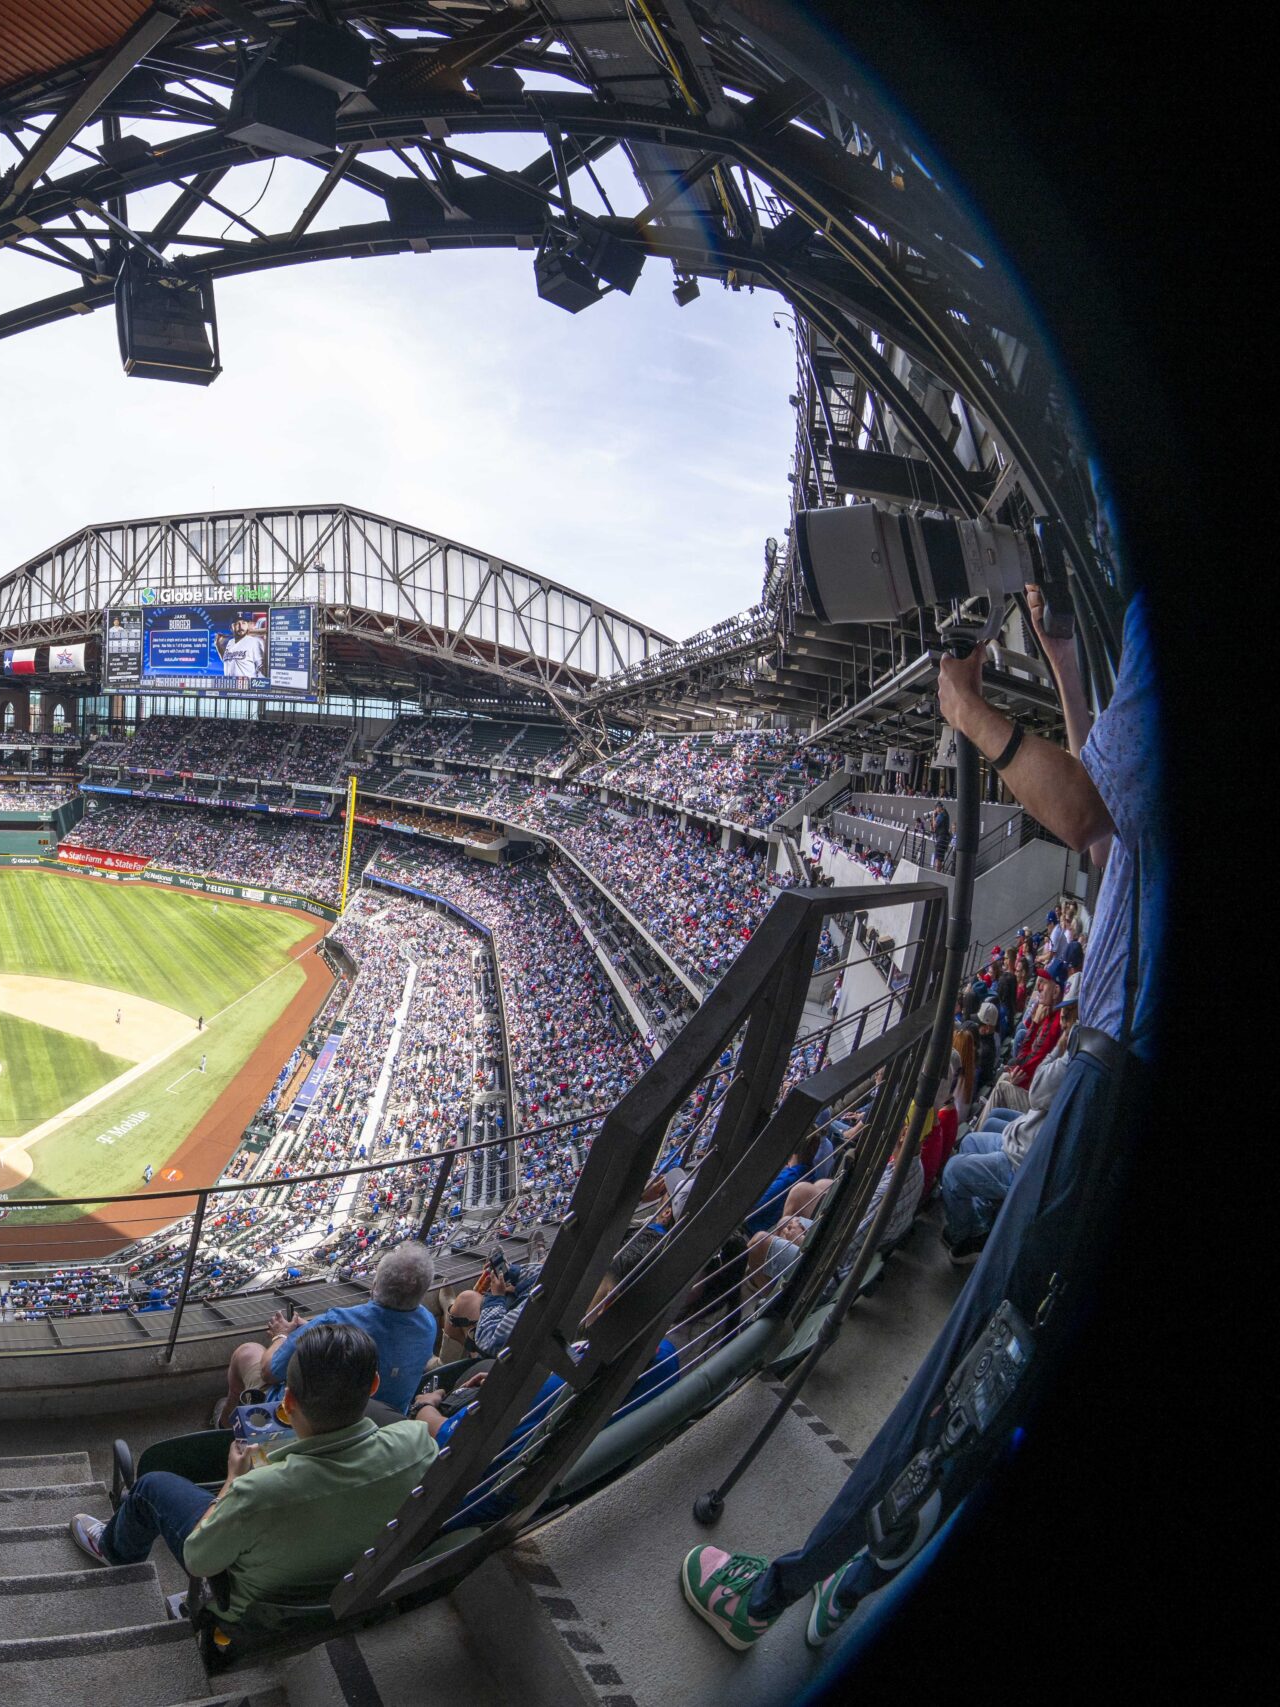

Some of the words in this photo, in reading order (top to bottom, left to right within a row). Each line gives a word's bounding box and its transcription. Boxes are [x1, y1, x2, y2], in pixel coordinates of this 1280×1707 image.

[160, 588, 202, 603] Globe
[205, 586, 232, 601] Life
[235, 584, 271, 600] Field
[168, 619, 191, 630] BURGER
[68, 851, 103, 864] StateFarm
[114, 858, 144, 870] StateFar
[150, 872, 173, 881] National
[205, 884, 234, 895] 7-ELEVEN
[307, 902, 325, 917] Mobile
[106, 1111, 151, 1138] Mobile
